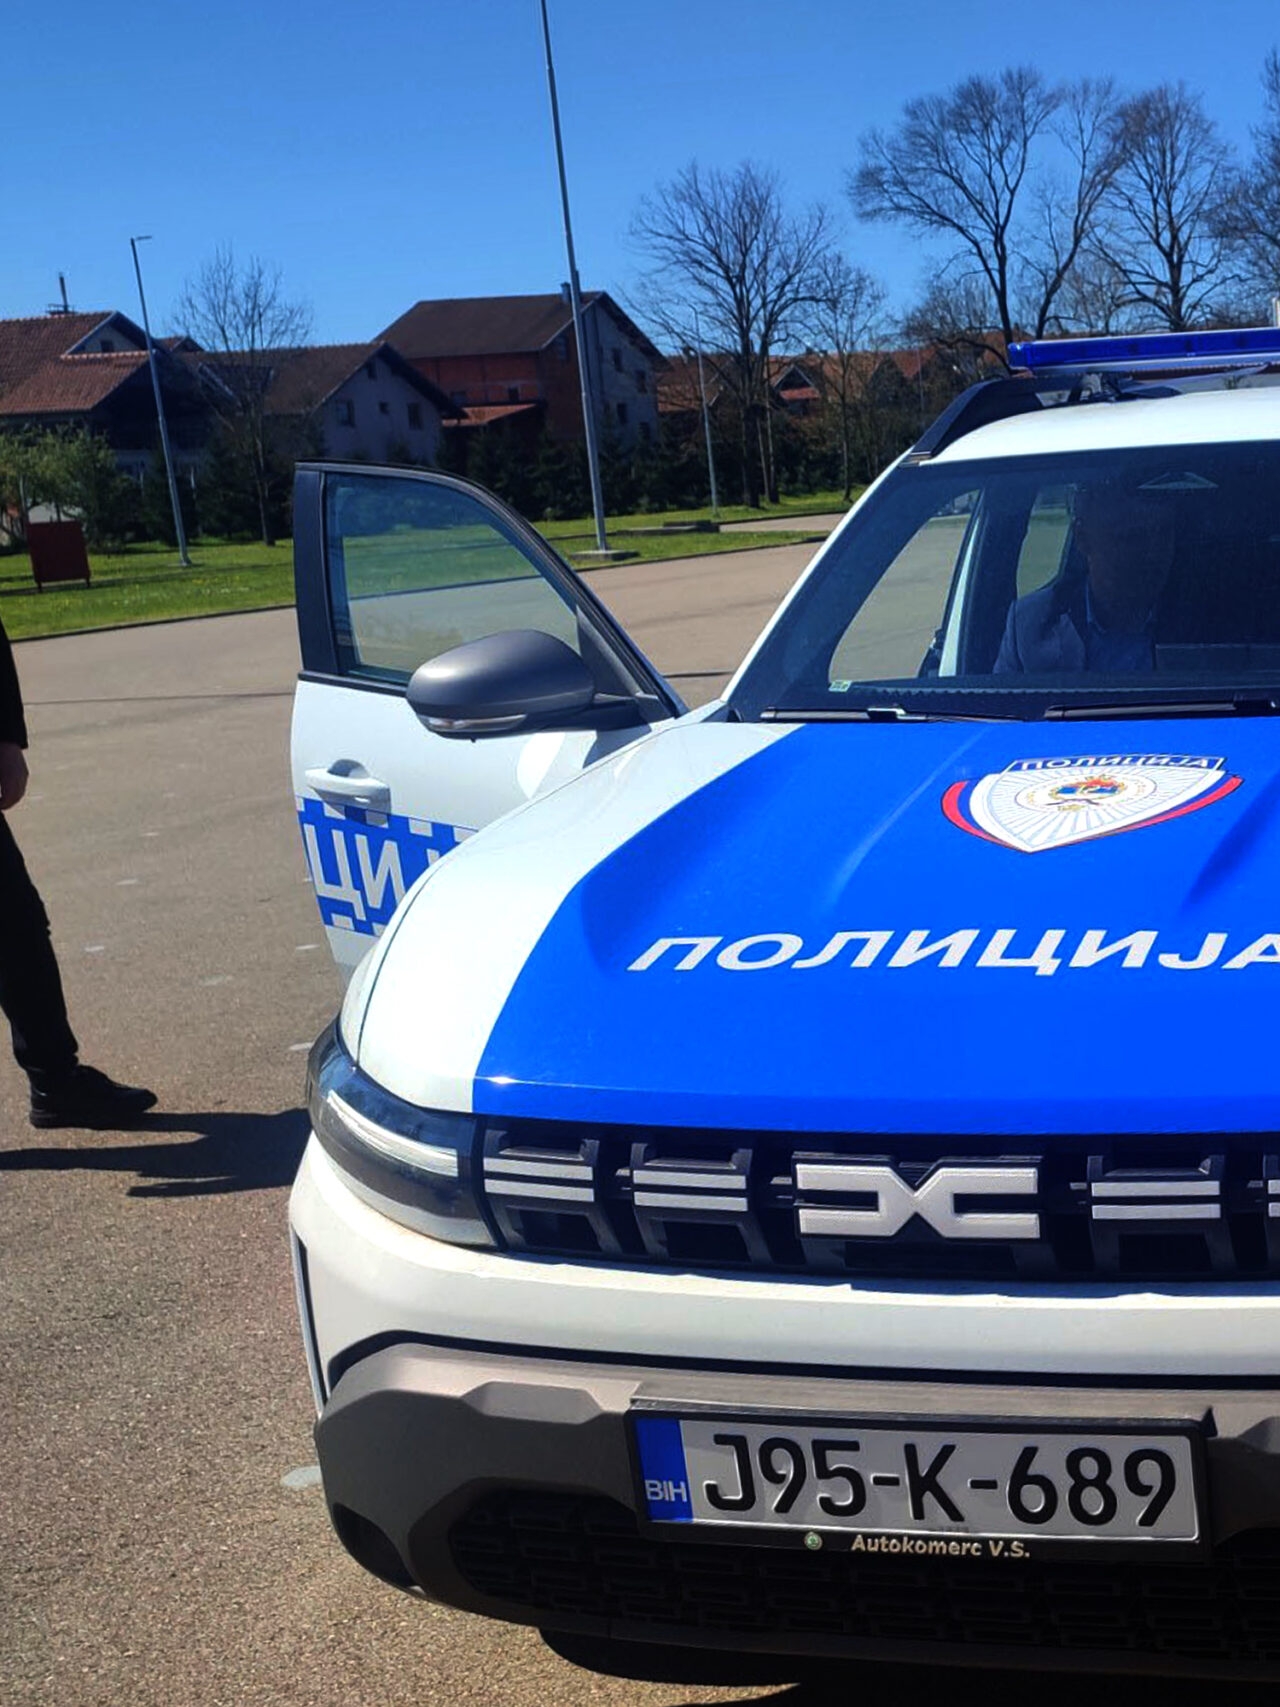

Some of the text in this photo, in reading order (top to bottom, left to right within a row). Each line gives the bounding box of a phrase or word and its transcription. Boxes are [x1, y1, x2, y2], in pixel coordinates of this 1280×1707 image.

[1021, 754, 1210, 770] ПОЛИЦИЈА
[645, 1479, 688, 1502] BIH
[704, 1433, 1178, 1528] J95-K-689
[851, 1534, 1030, 1558] Autokomerc V.S.
